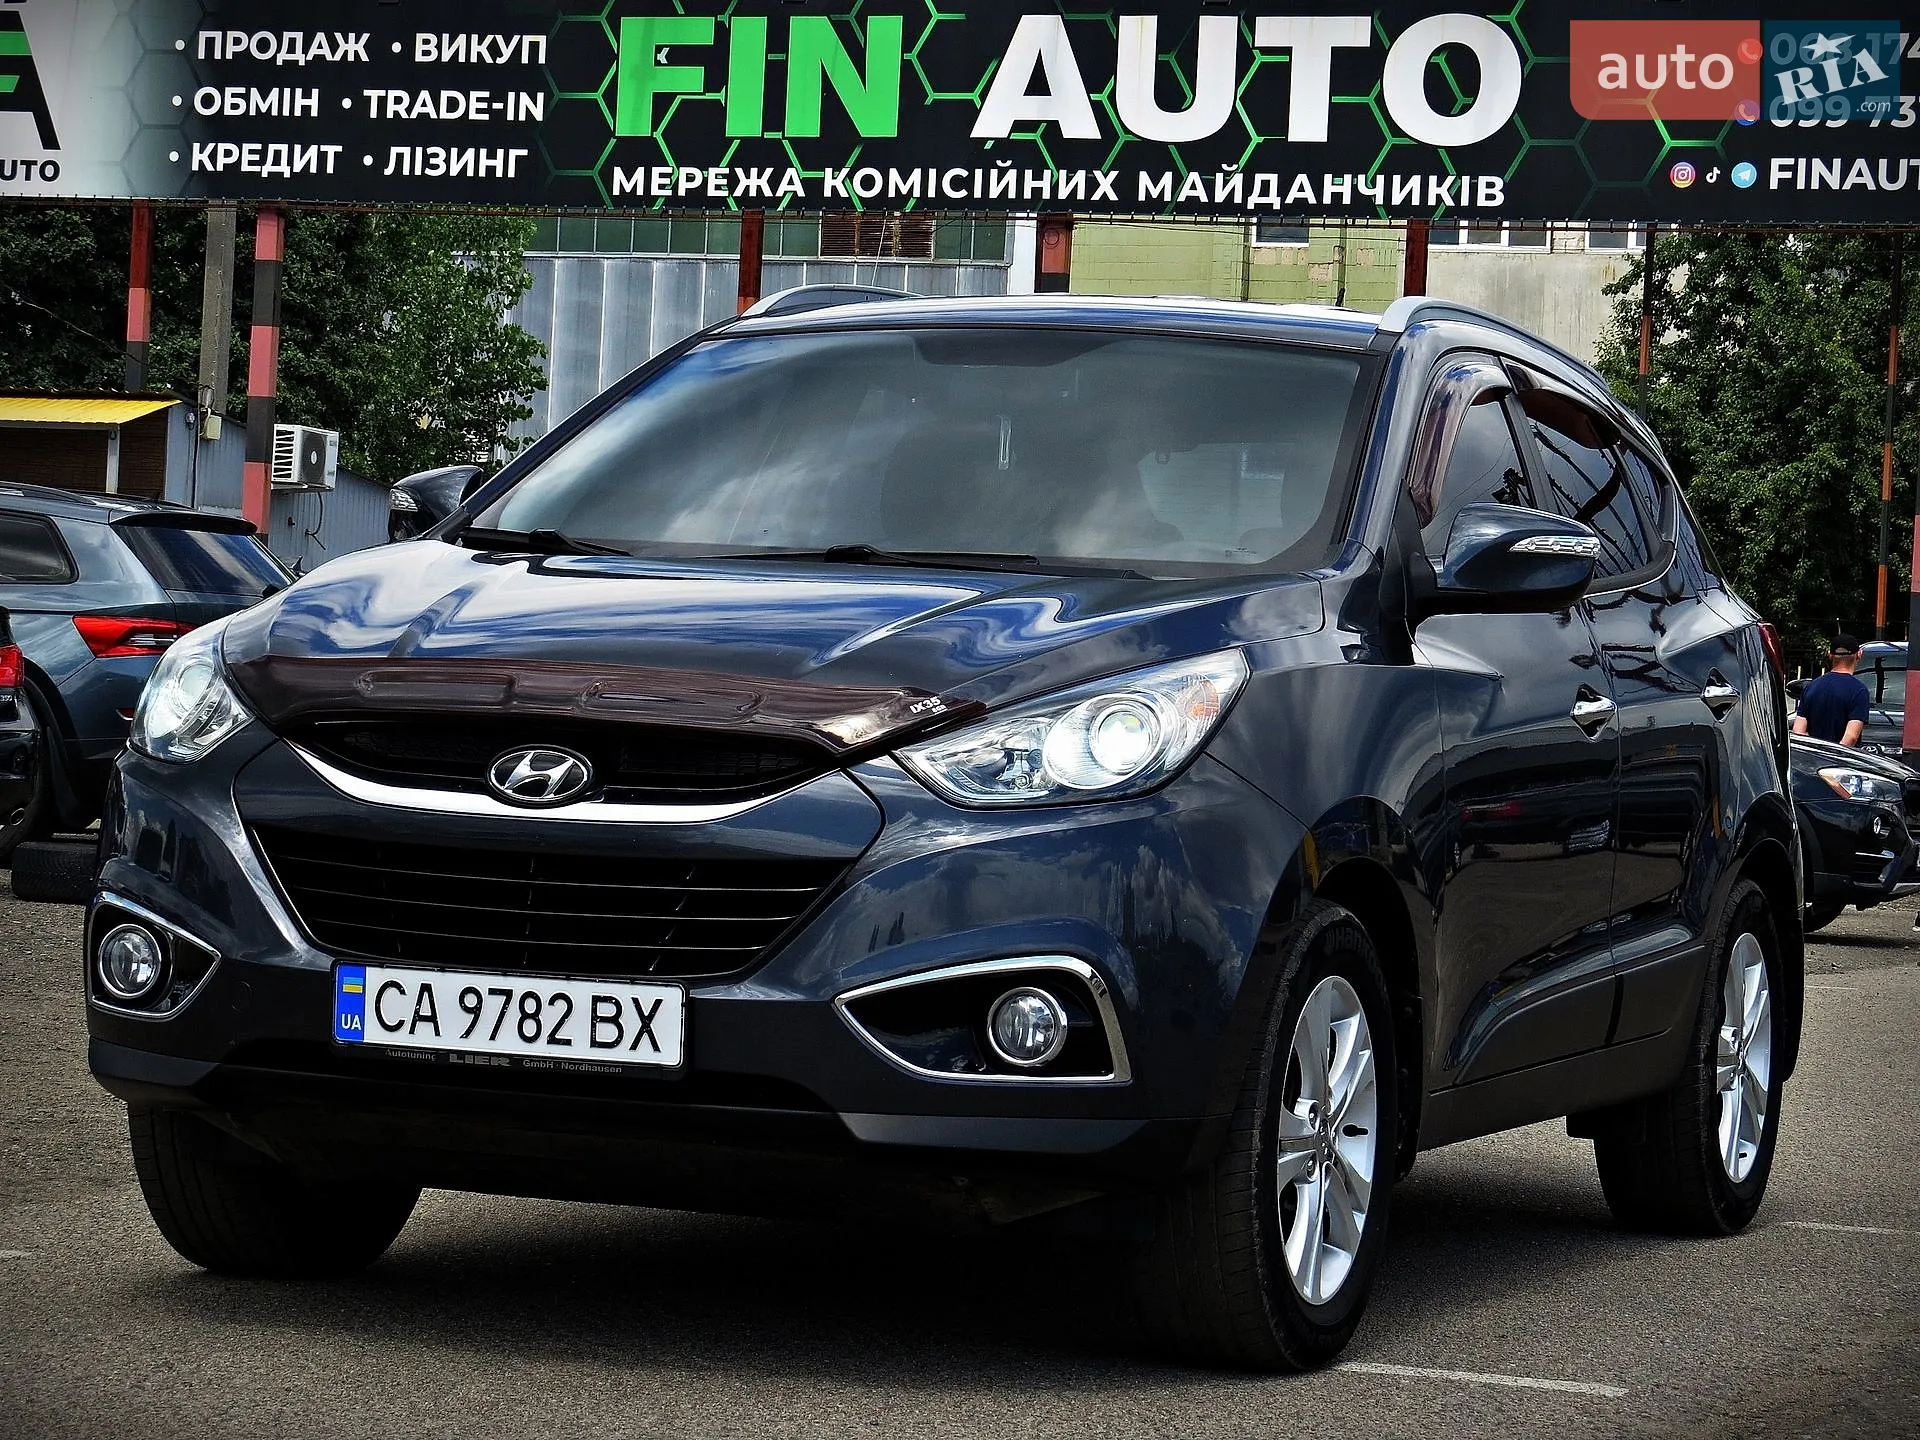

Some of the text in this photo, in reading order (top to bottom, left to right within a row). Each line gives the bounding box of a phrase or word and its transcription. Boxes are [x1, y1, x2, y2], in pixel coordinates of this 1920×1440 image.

[197, 31, 547, 66] ПРОДАЖ ВИКУП
[615, 14, 1522, 147] FIN AUTO
[193, 87, 545, 122] ОБМІН TRADE-IN
[1769, 95, 1920, 128] 099 73
[191, 143, 528, 178] КРЕДИТ ЛІЗИНГ
[612, 160, 1505, 210] МЕРЕЖА КОМІСІЙНИХ МАЙДАНЧИКІВ
[909, 696, 941, 714] IX35
[341, 1013, 362, 1031] UA
[374, 979, 663, 1053] CA 9782 BX
[385, 1049, 437, 1061] Autotuning
[522, 1059, 554, 1069] GmbH
[561, 1061, 622, 1074] Nordhausen
